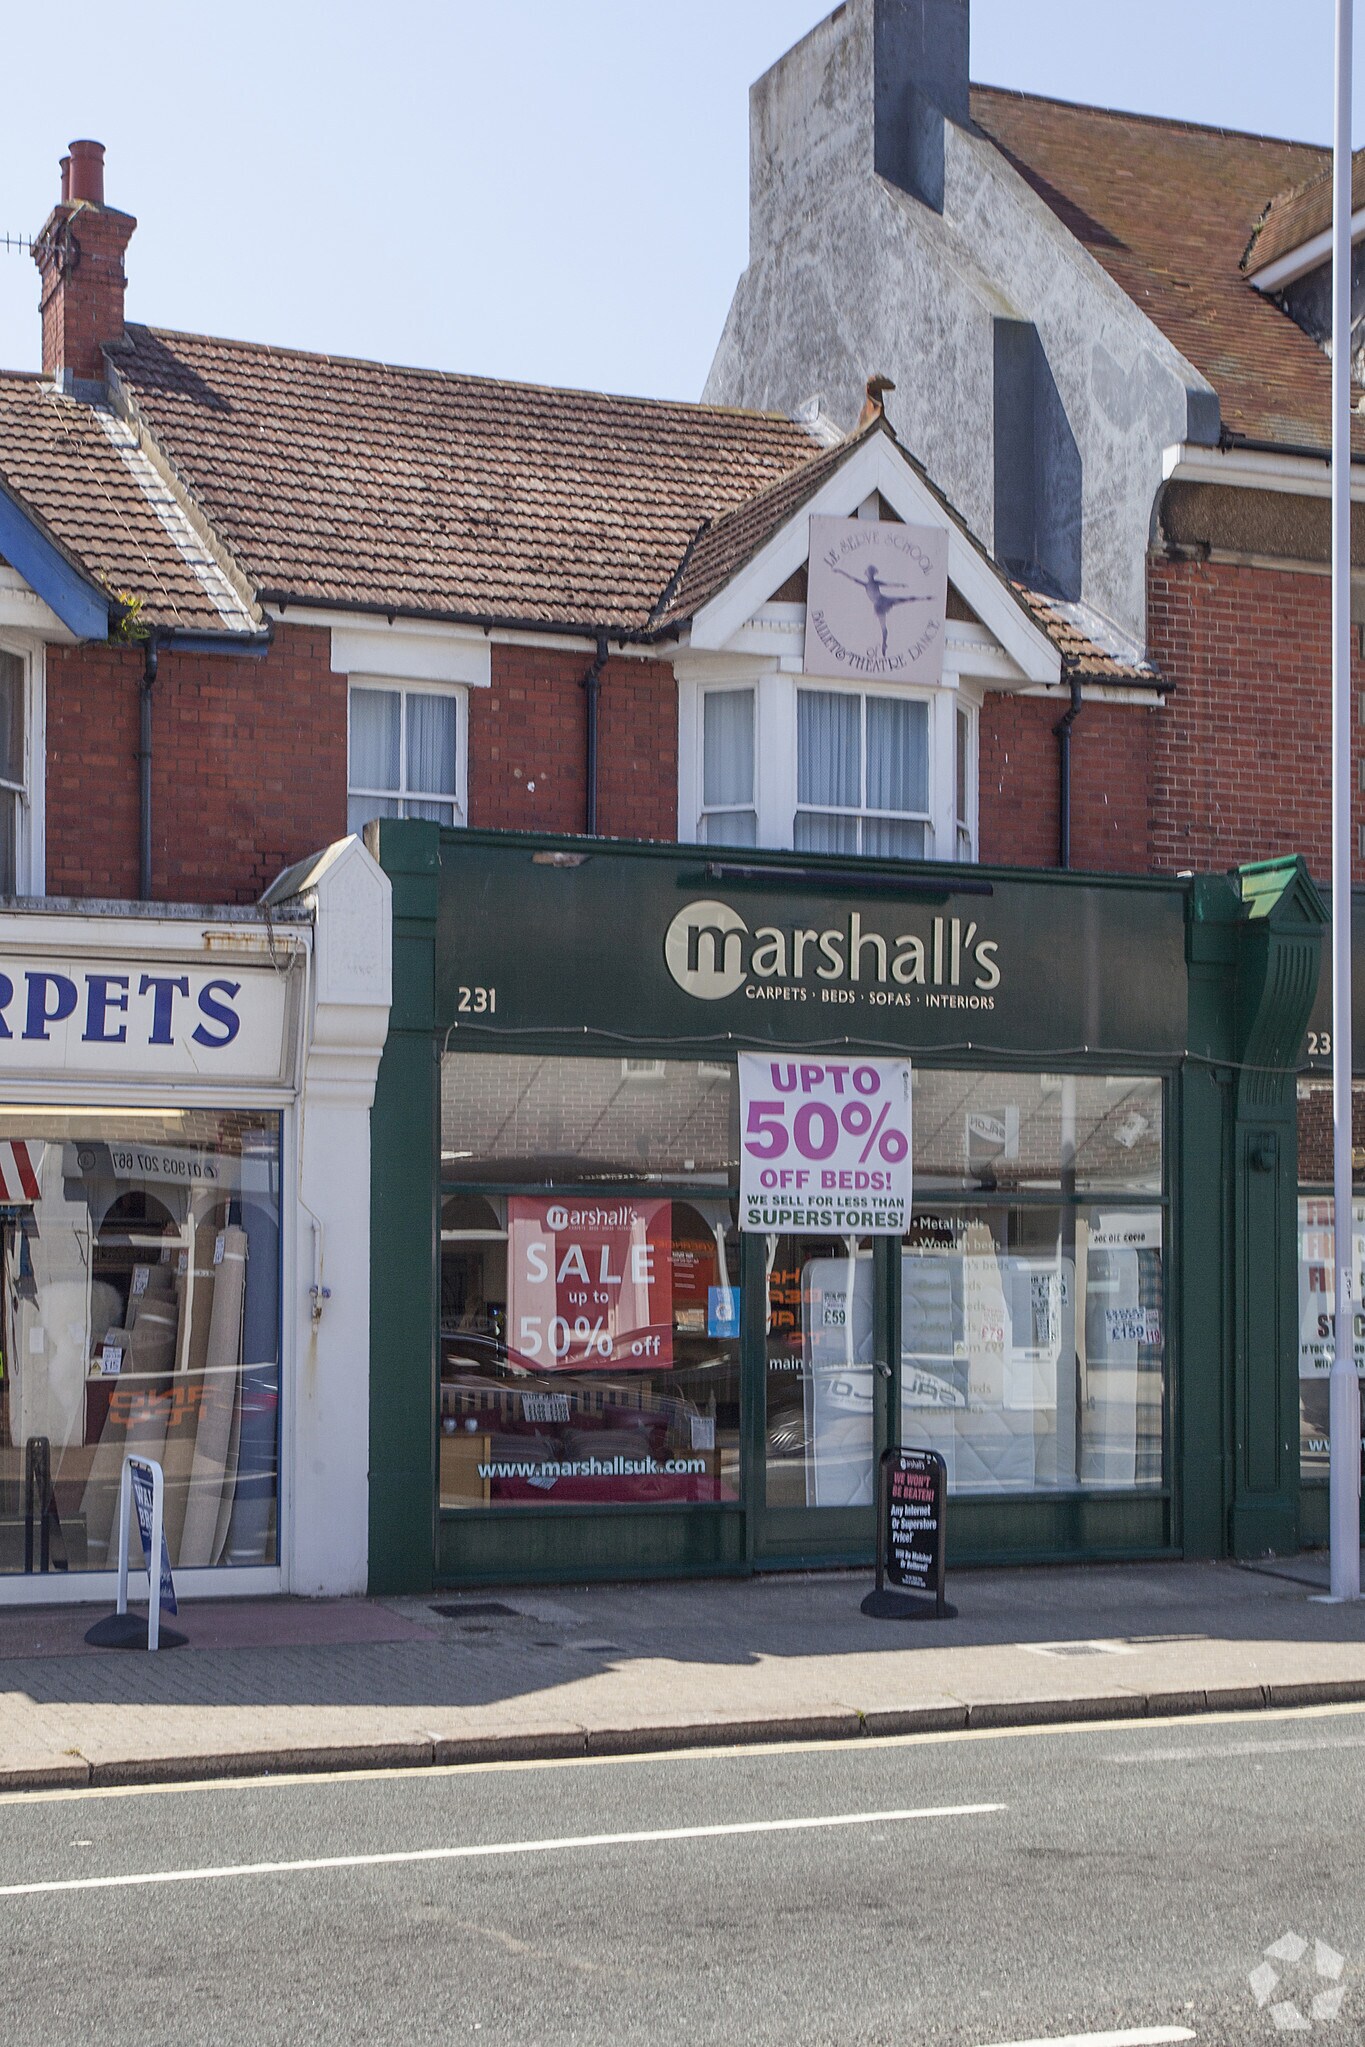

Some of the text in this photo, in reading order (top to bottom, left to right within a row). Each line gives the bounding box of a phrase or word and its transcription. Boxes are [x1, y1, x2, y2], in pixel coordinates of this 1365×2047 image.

[665, 899, 1001, 1000] marshall's
[458, 986, 496, 1014] 231
[745, 985, 995, 1010] CARPETS BEDS SOFAS INTERIORS
[0, 971, 241, 1048] PETS
[744, 1100, 909, 1165] 50%
[760, 1169, 892, 1191] OFF BEDS!
[747, 1194, 905, 1208] WE SELL FOR LESS THAN
[546, 1204, 639, 1232] marshall's
[747, 1209, 904, 1228] SUPERSTORES!
[920, 1216, 985, 1231] Metal beds
[526, 1242, 656, 1285] SALE
[568, 1290, 609, 1306] up to
[520, 1315, 661, 1359] 50% off
[769, 1354, 803, 1371] main
[477, 1455, 707, 1479] www.marshallsuk.com
[894, 1471, 906, 1486] WE
[892, 1484, 903, 1498] BE
[890, 1503, 931, 1518] Any Internet
[900, 1517, 937, 1531] Superstore
